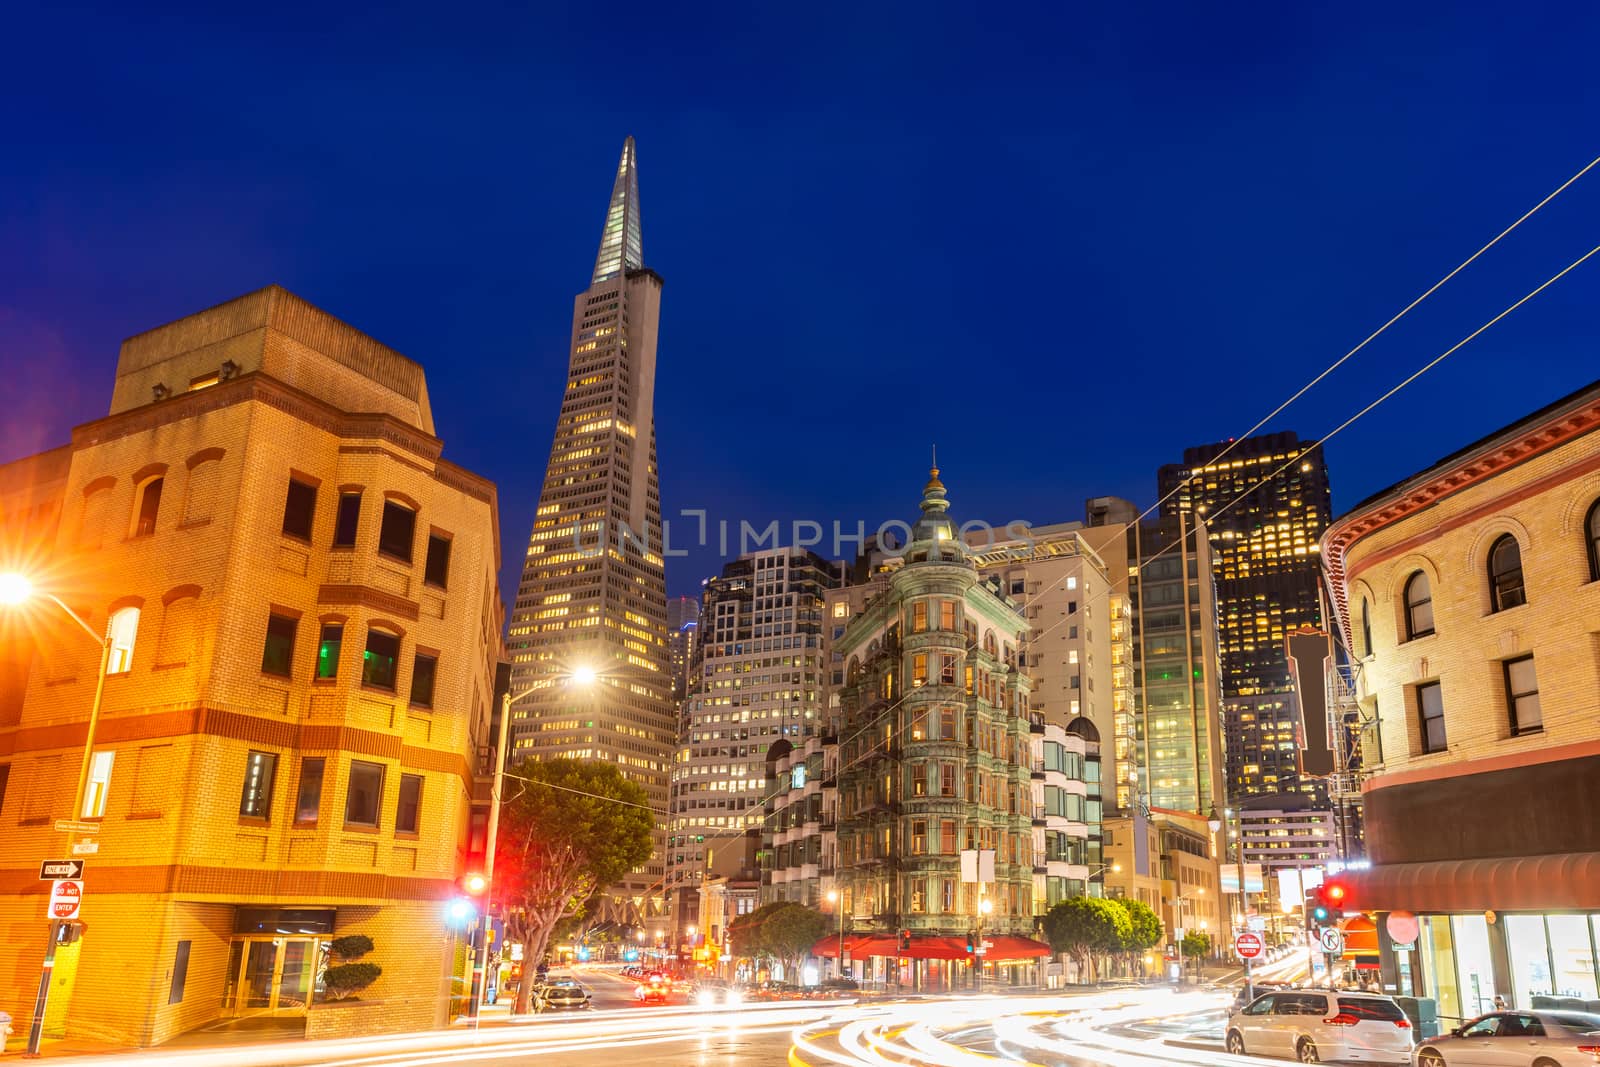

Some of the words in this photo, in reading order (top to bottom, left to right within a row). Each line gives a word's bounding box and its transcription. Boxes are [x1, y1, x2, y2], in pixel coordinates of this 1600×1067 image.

[55, 887, 65, 896] DO
[66, 888, 78, 896] NOT
[55, 903, 73, 911] ENTER
